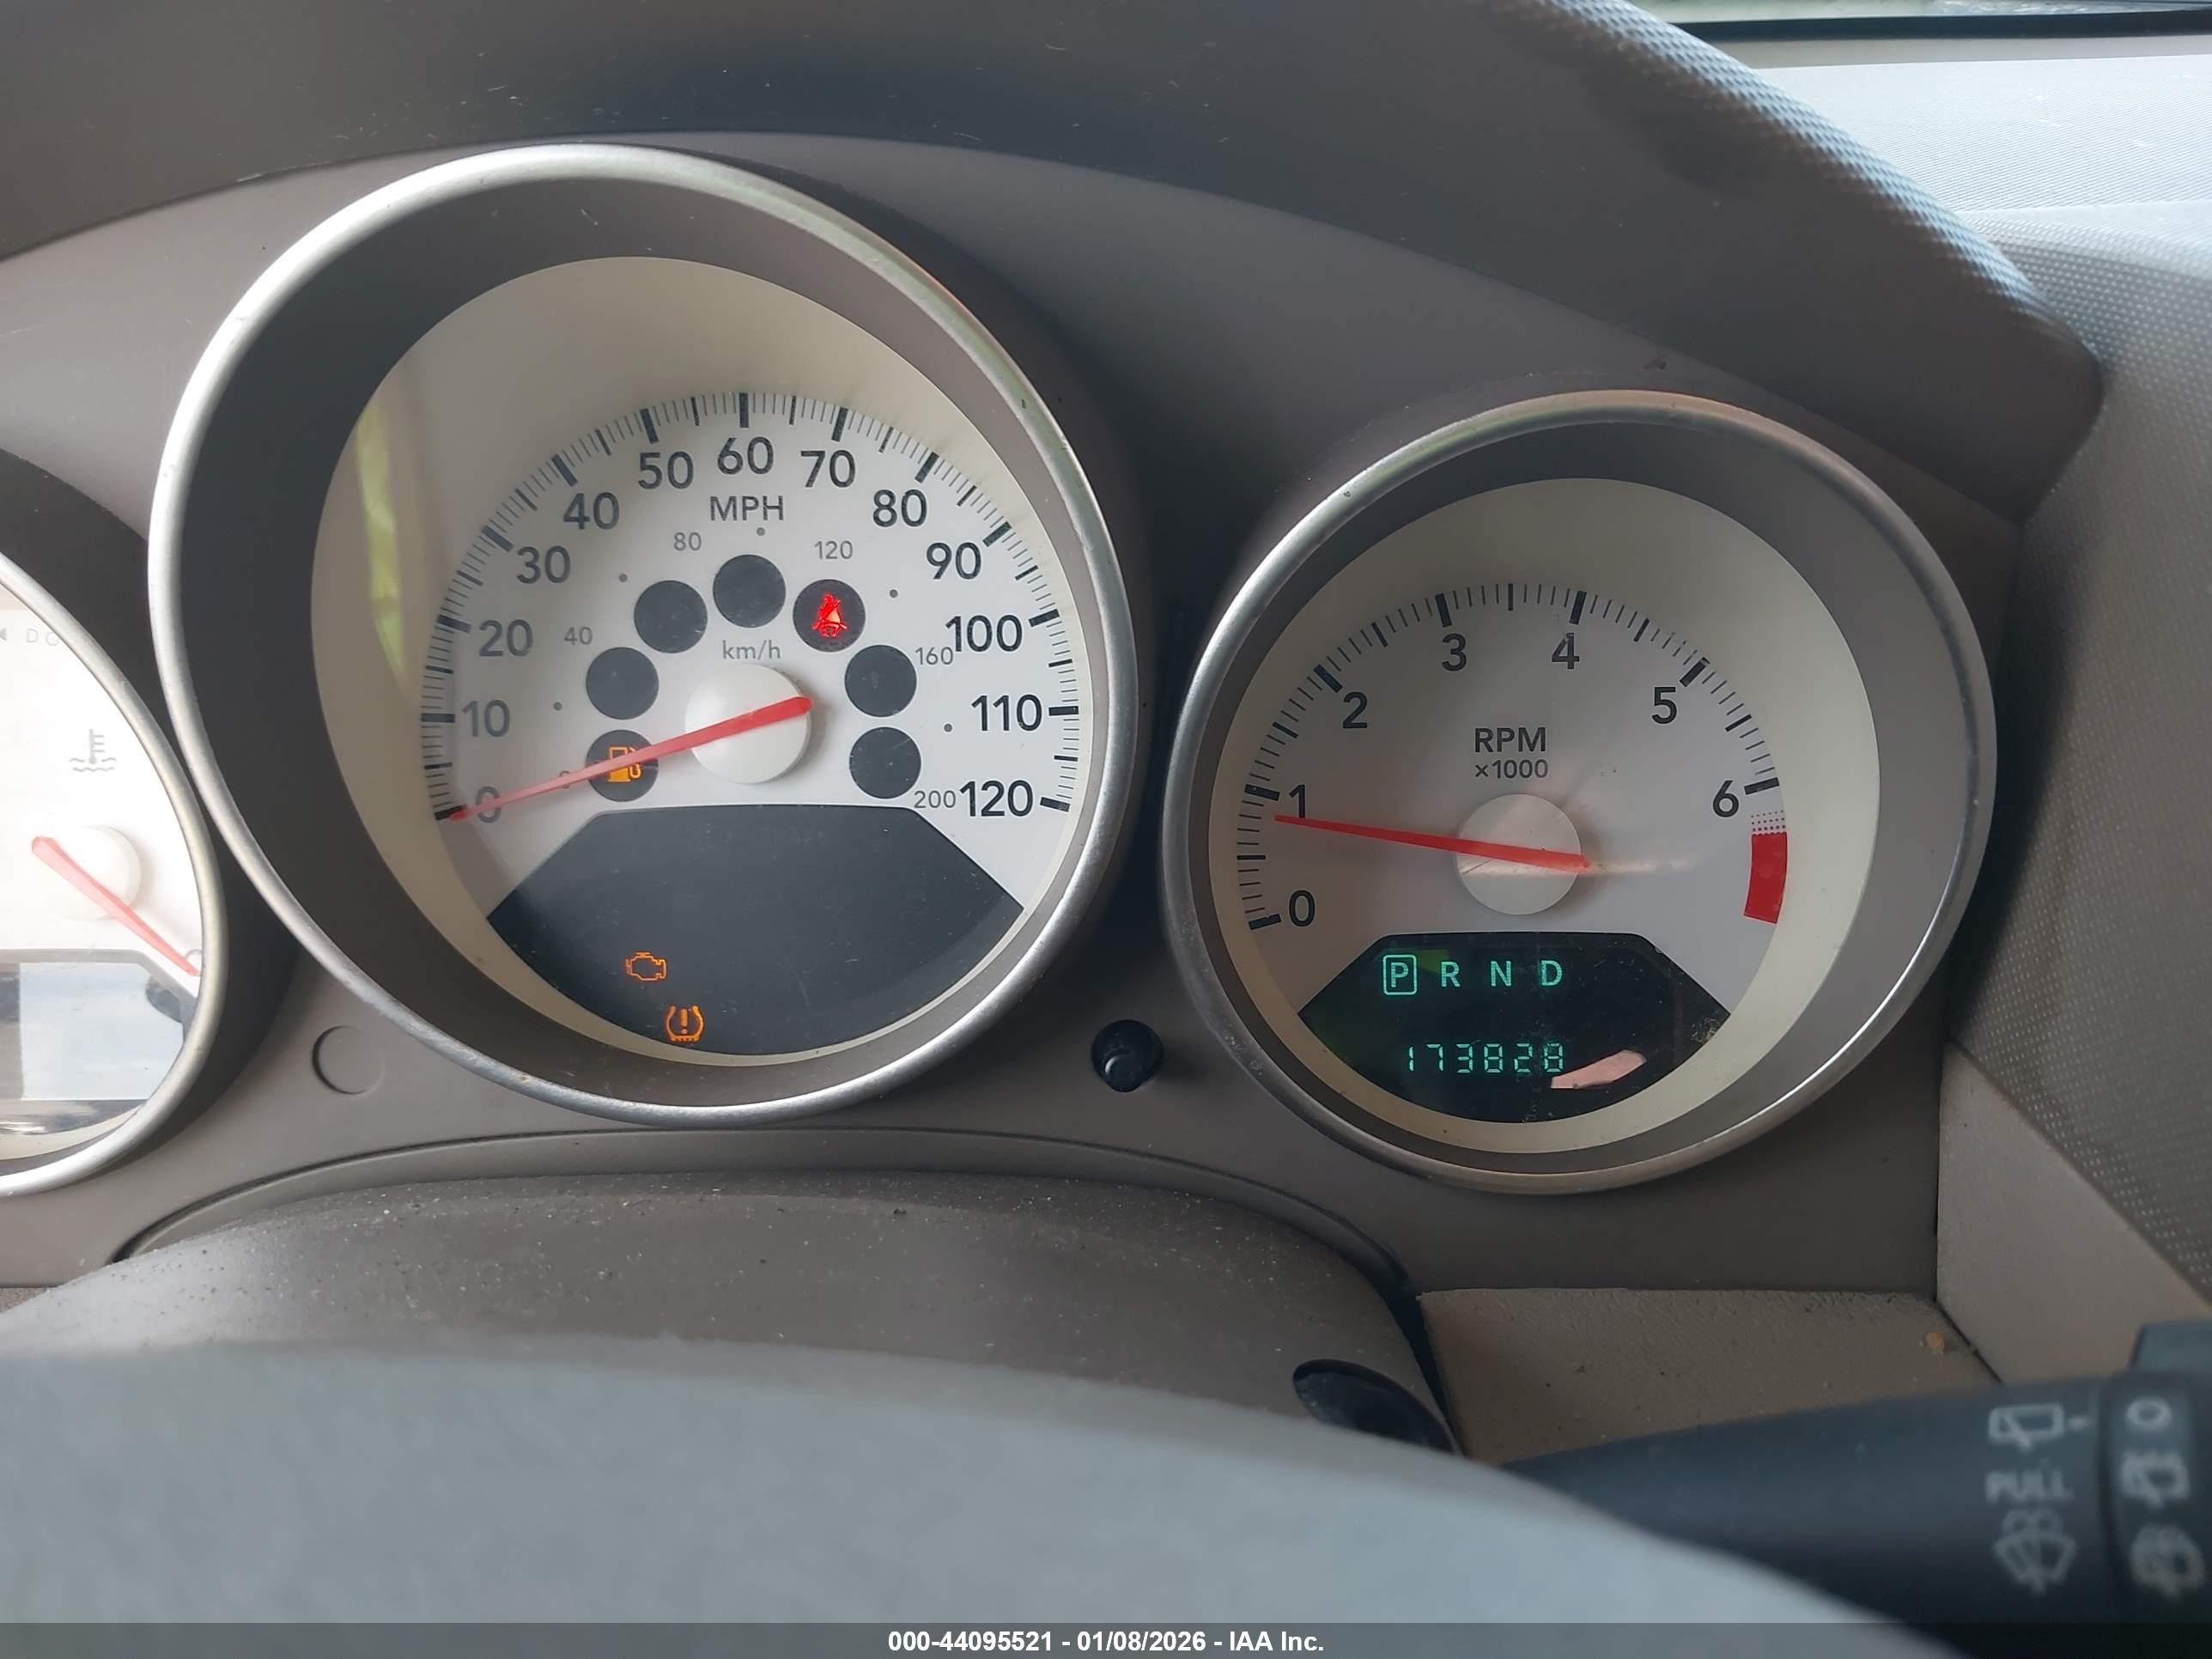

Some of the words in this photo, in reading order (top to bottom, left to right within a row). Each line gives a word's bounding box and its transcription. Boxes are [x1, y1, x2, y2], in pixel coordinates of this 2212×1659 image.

[638, 452, 693, 489] 50
[717, 437, 773, 474] 60
[801, 450, 855, 487] 70
[563, 492, 619, 530] 40
[710, 495, 783, 520] MPH
[873, 489, 927, 527] 80
[673, 532, 702, 551] 80
[815, 541, 853, 560] 120
[517, 546, 570, 584] 30
[927, 543, 981, 579] 90
[479, 619, 532, 656] 20
[563, 627, 592, 645] 40
[722, 640, 781, 660] km/h
[945, 615, 1022, 653] 100
[1552, 633, 1579, 669] 4
[915, 647, 953, 665] 160
[1442, 634, 1467, 671] 3
[462, 700, 509, 737] 10
[972, 695, 1042, 731] 110
[1342, 691, 1367, 728] 2
[1652, 687, 1677, 724] 5
[1475, 727, 1546, 752] RPM
[476, 786, 501, 823] 0
[914, 790, 956, 810] 200
[960, 781, 1033, 817] 120
[1289, 784, 1306, 819] 1
[1713, 781, 1739, 817] 6
[1289, 890, 1315, 927] 0
[1390, 962, 1409, 988] P
[1440, 961, 1461, 987] R
[1490, 960, 1512, 987] N
[1540, 959, 1563, 986] D
[1408, 1042, 1564, 1073] 173828
